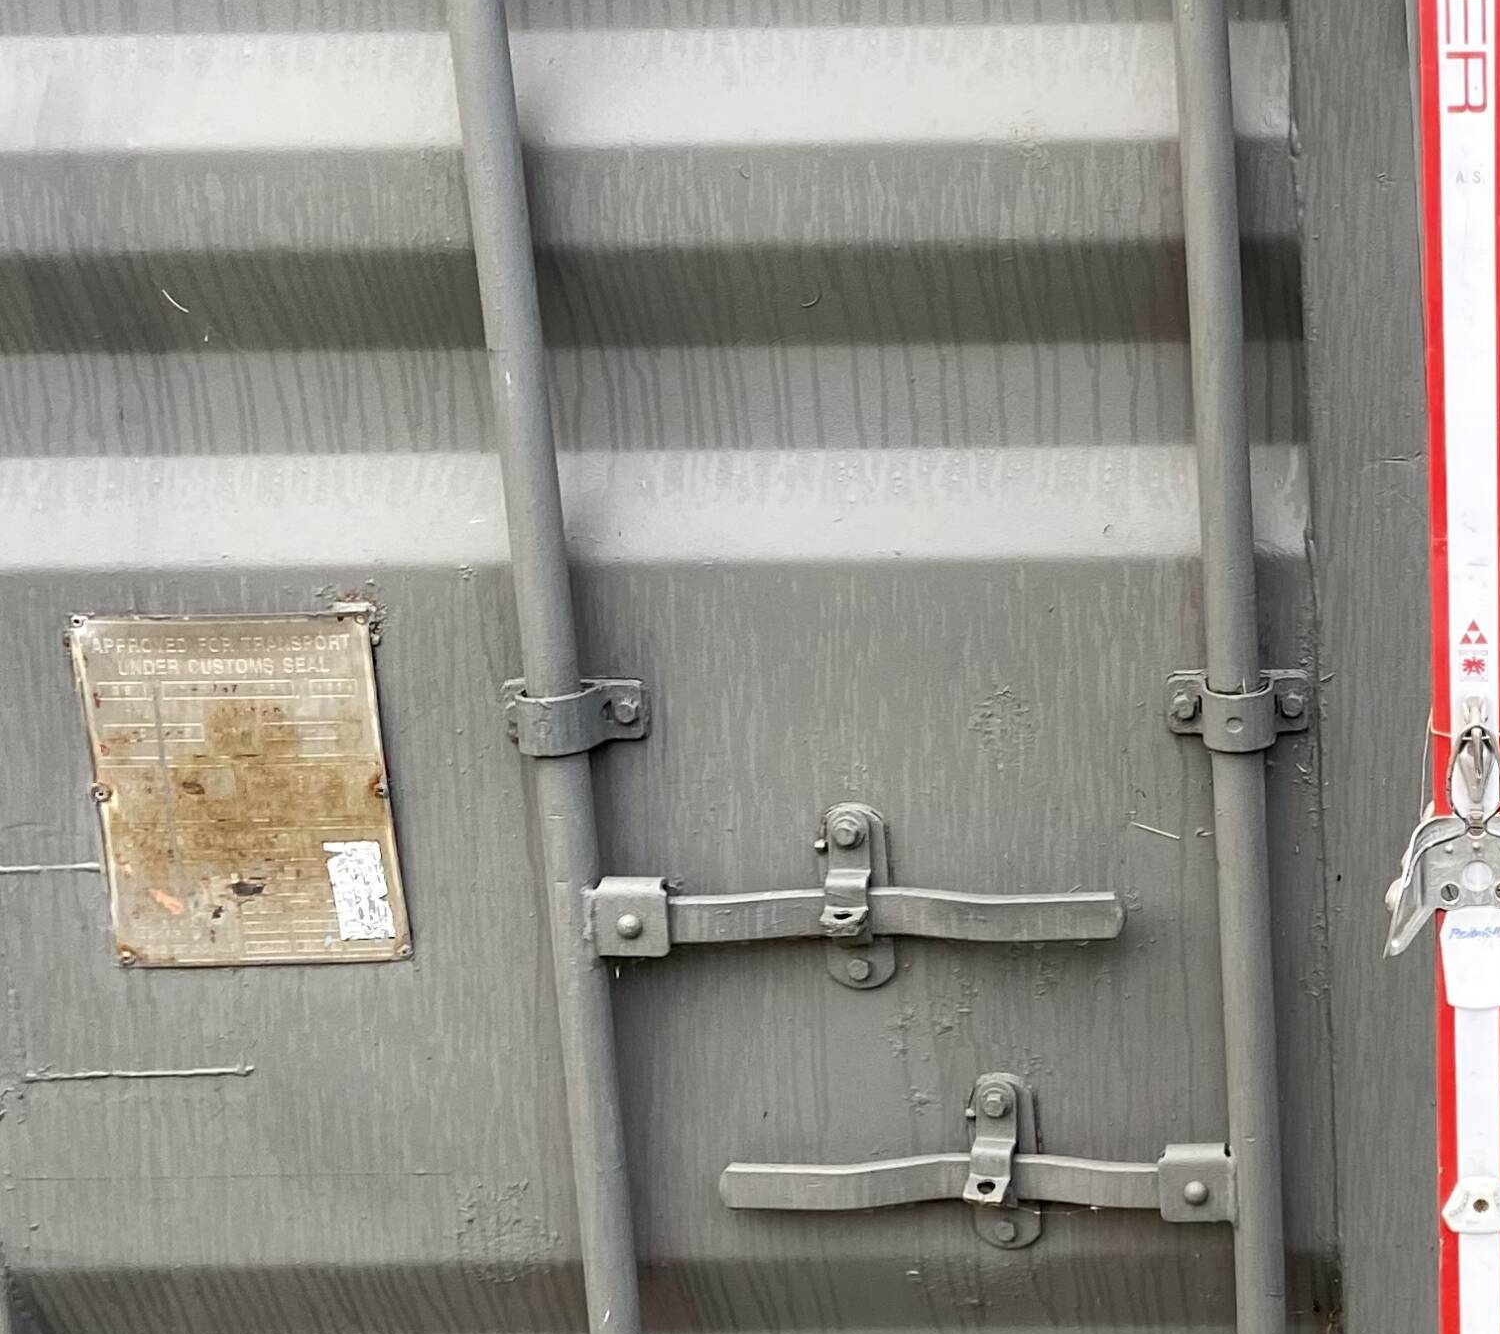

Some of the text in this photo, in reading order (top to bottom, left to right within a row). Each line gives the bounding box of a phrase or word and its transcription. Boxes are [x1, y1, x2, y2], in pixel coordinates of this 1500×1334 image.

[92, 633, 350, 654] APPROVED FOR TRANSPORT
[118, 656, 330, 676] UNDER CUSTOMS SEAL
